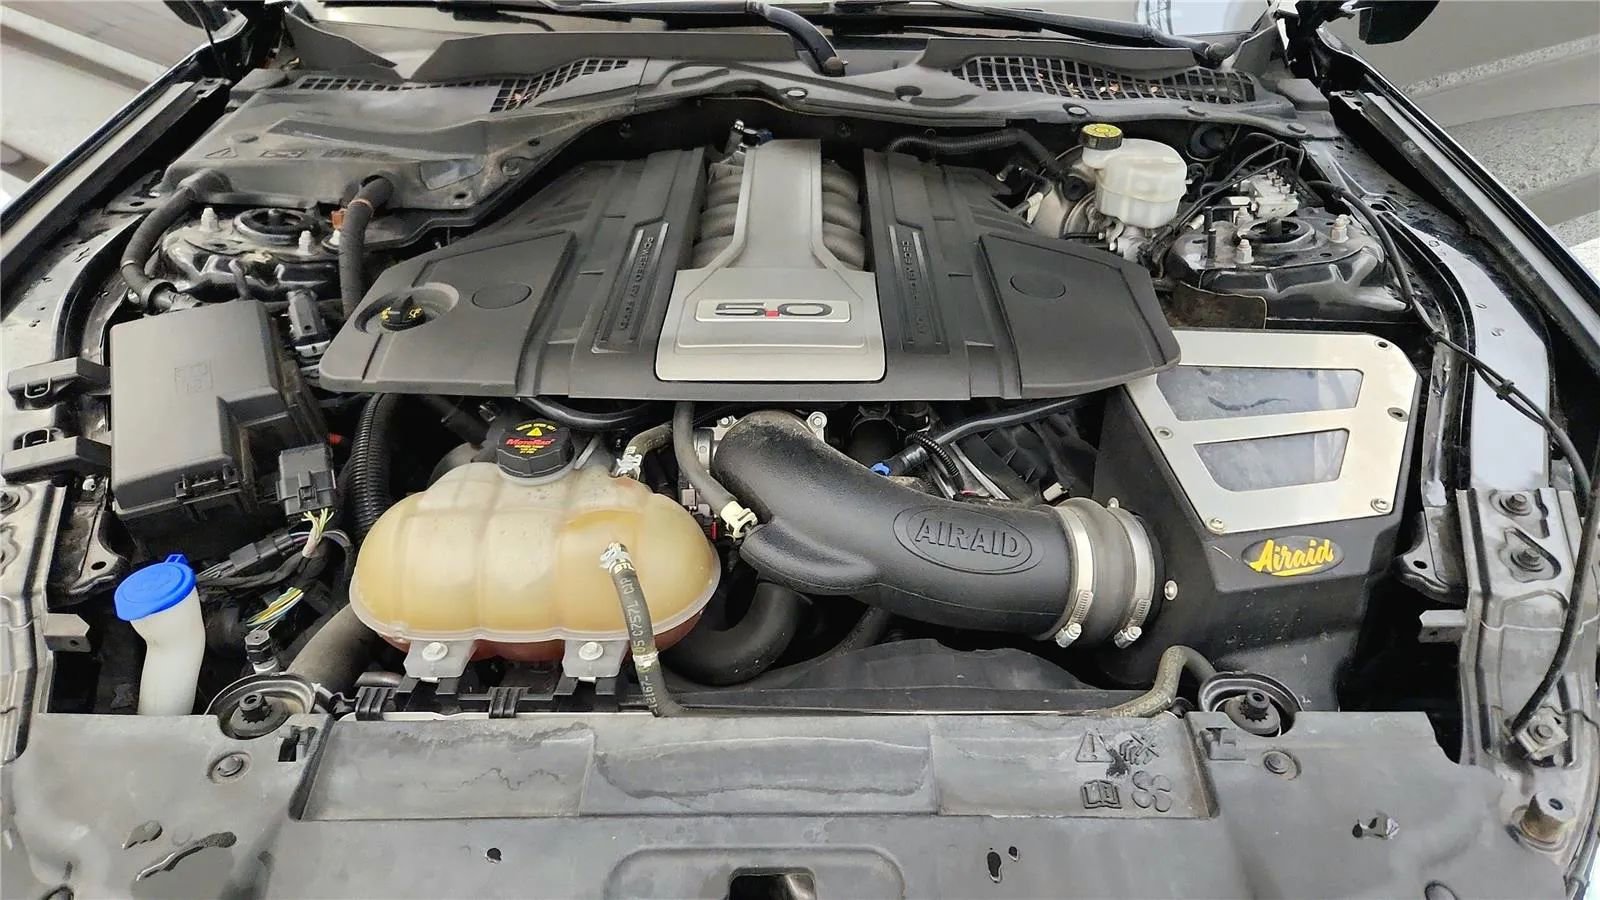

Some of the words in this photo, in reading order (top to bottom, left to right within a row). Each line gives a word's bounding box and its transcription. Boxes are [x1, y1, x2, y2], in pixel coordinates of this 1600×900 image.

[715, 302, 833, 317] 5.0
[915, 518, 1023, 557] AIRAID
[1249, 539, 1334, 572] Airaid
